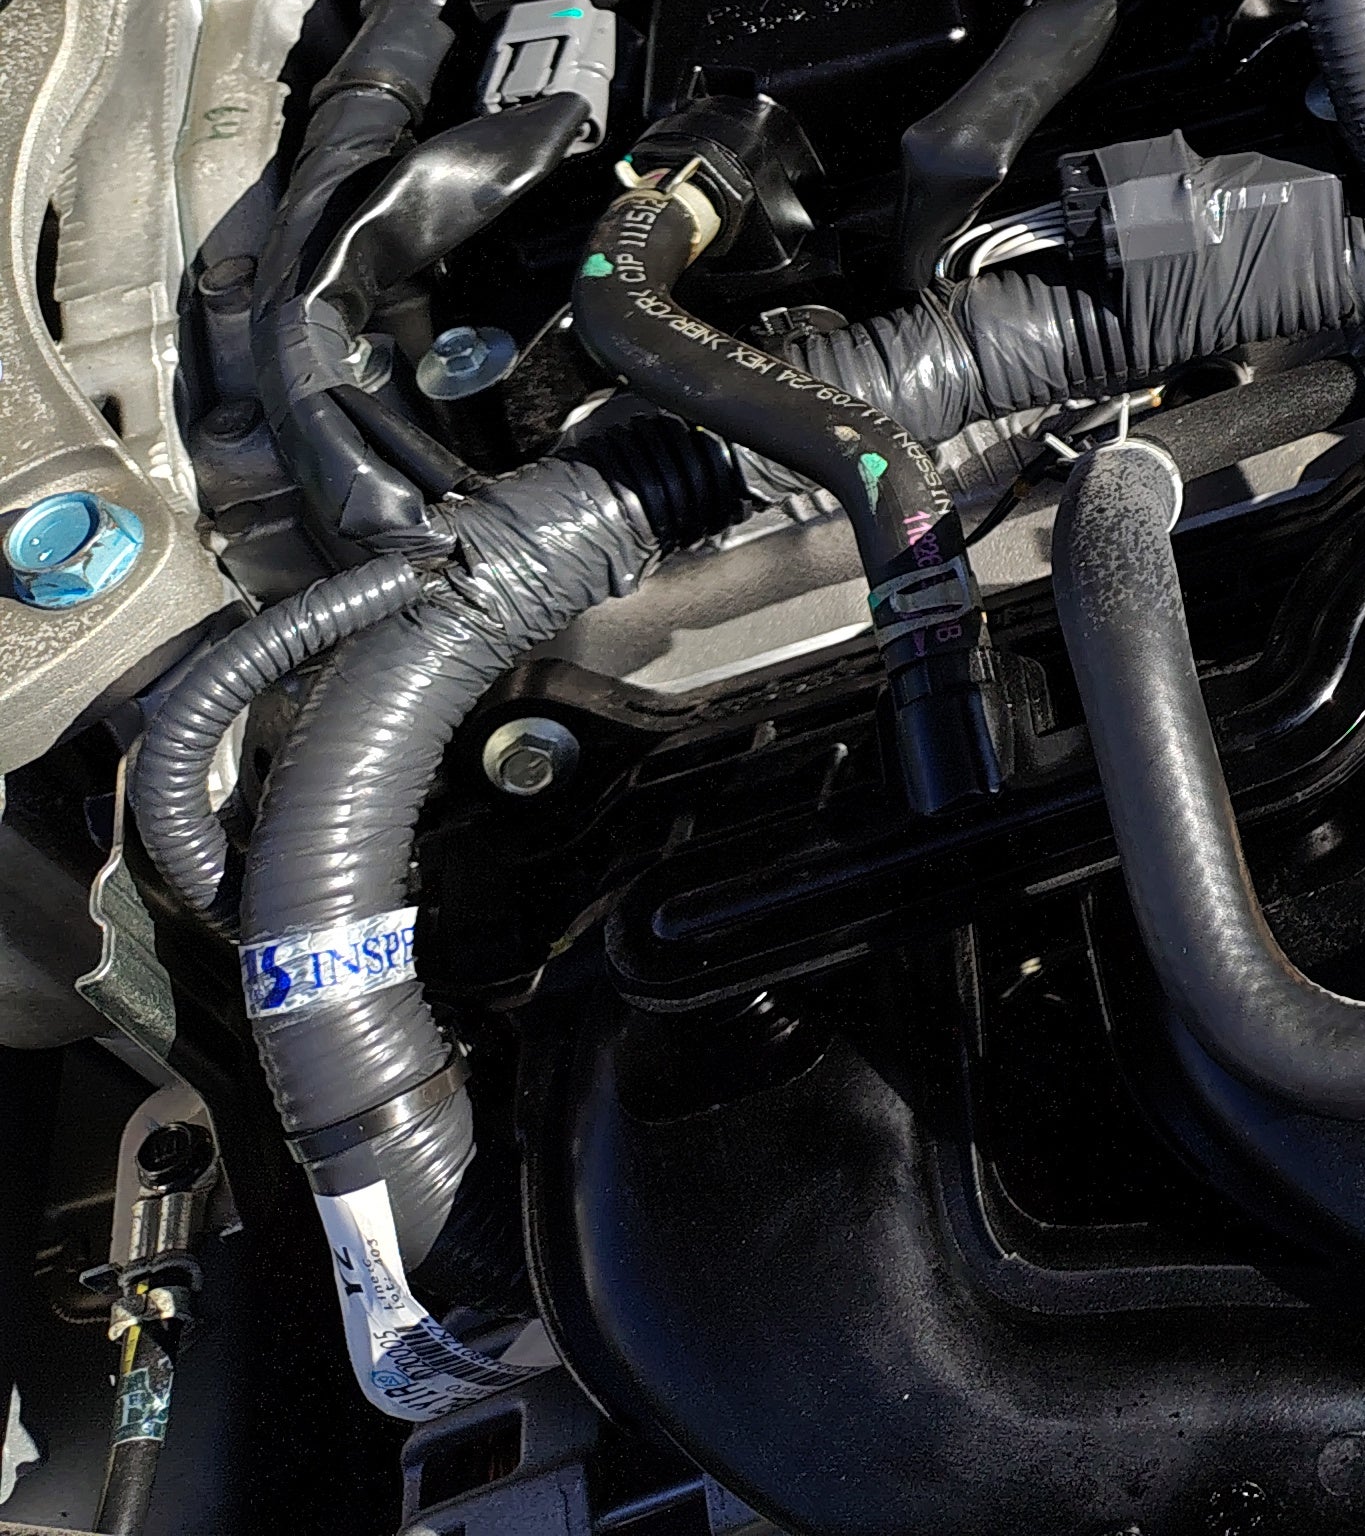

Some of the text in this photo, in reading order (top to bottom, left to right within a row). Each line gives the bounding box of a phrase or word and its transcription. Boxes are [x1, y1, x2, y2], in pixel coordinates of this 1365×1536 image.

[726, 346, 777, 375] MEX
[776, 369, 891, 425] 11/09/24
[893, 432, 951, 514] NISSAN
